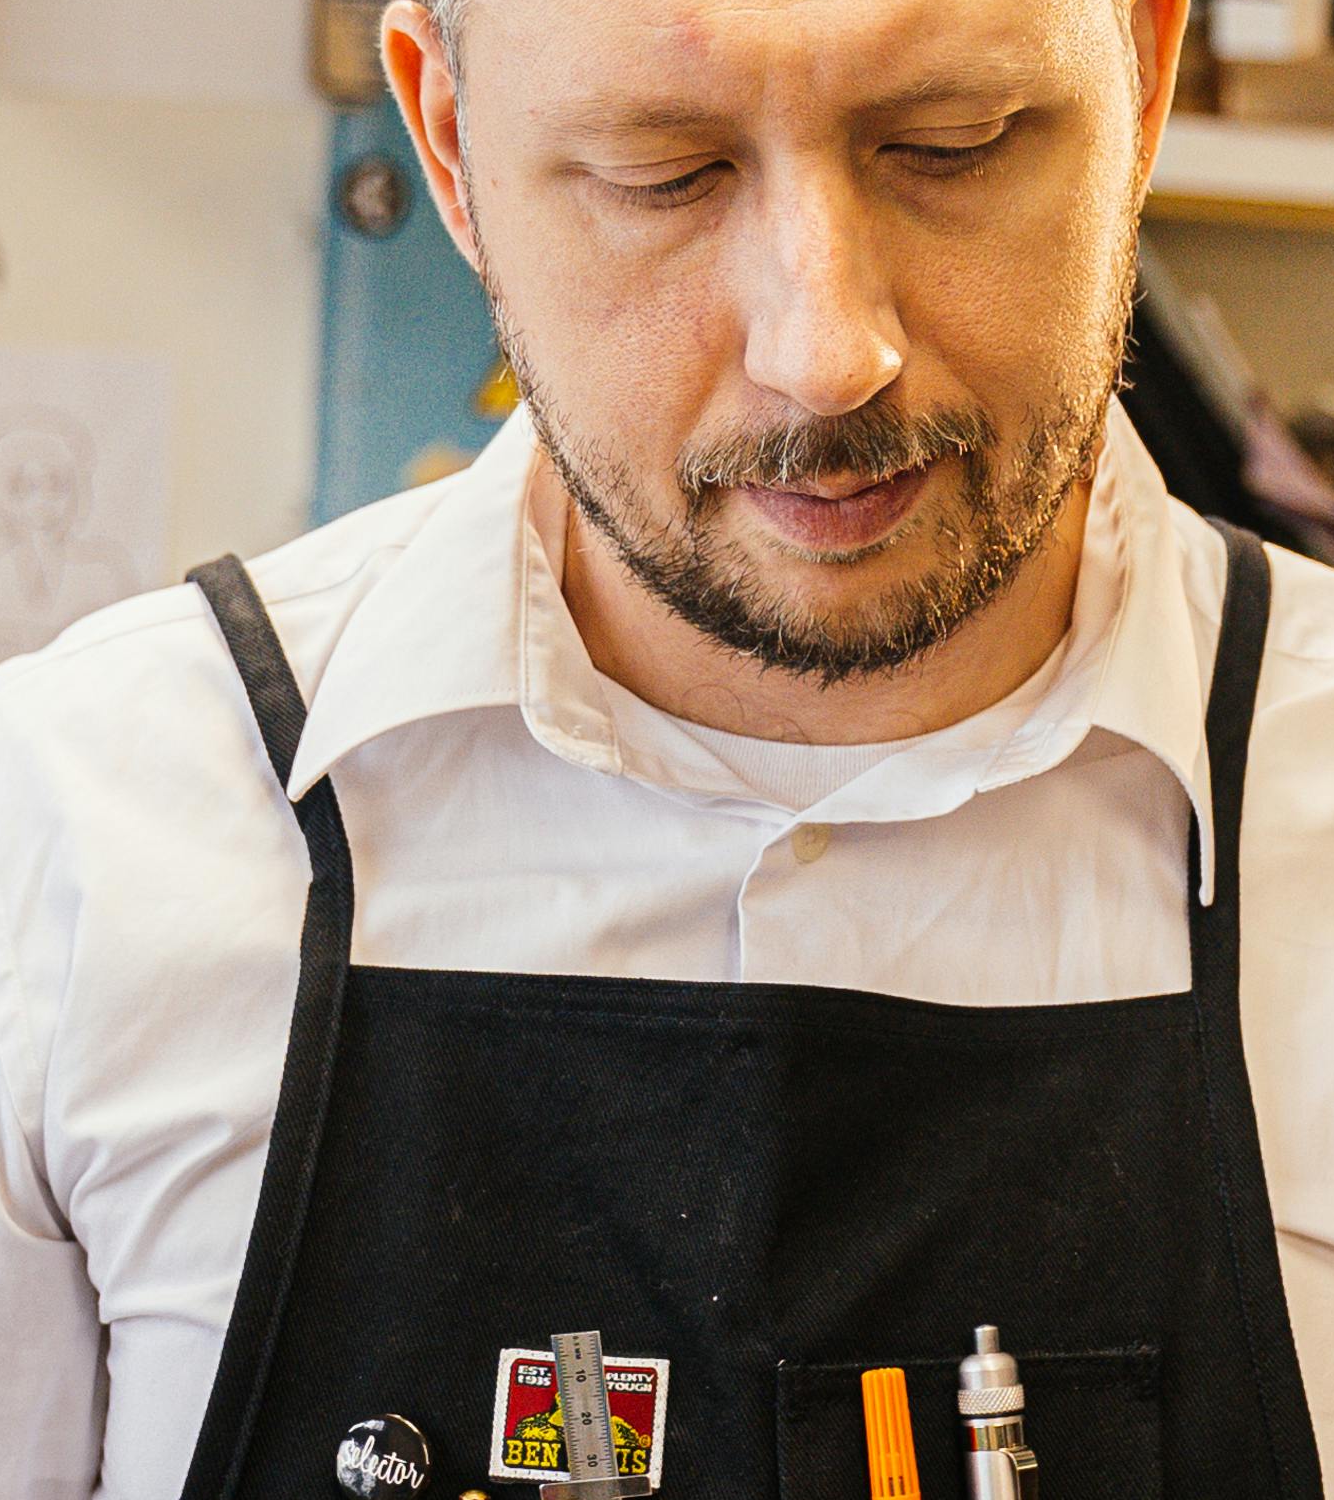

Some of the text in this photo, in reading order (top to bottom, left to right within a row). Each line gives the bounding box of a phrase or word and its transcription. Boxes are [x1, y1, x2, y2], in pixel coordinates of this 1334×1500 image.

[518, 1365, 551, 1377] EST.
[576, 1369, 587, 1383] 10
[606, 1372, 655, 1382] PLENTY
[518, 1375, 551, 1387] 1935
[607, 1382, 652, 1393] TOUGH
[581, 1412, 592, 1426] 20
[505, 1440, 561, 1468] BEN
[587, 1453, 598, 1468] 30
